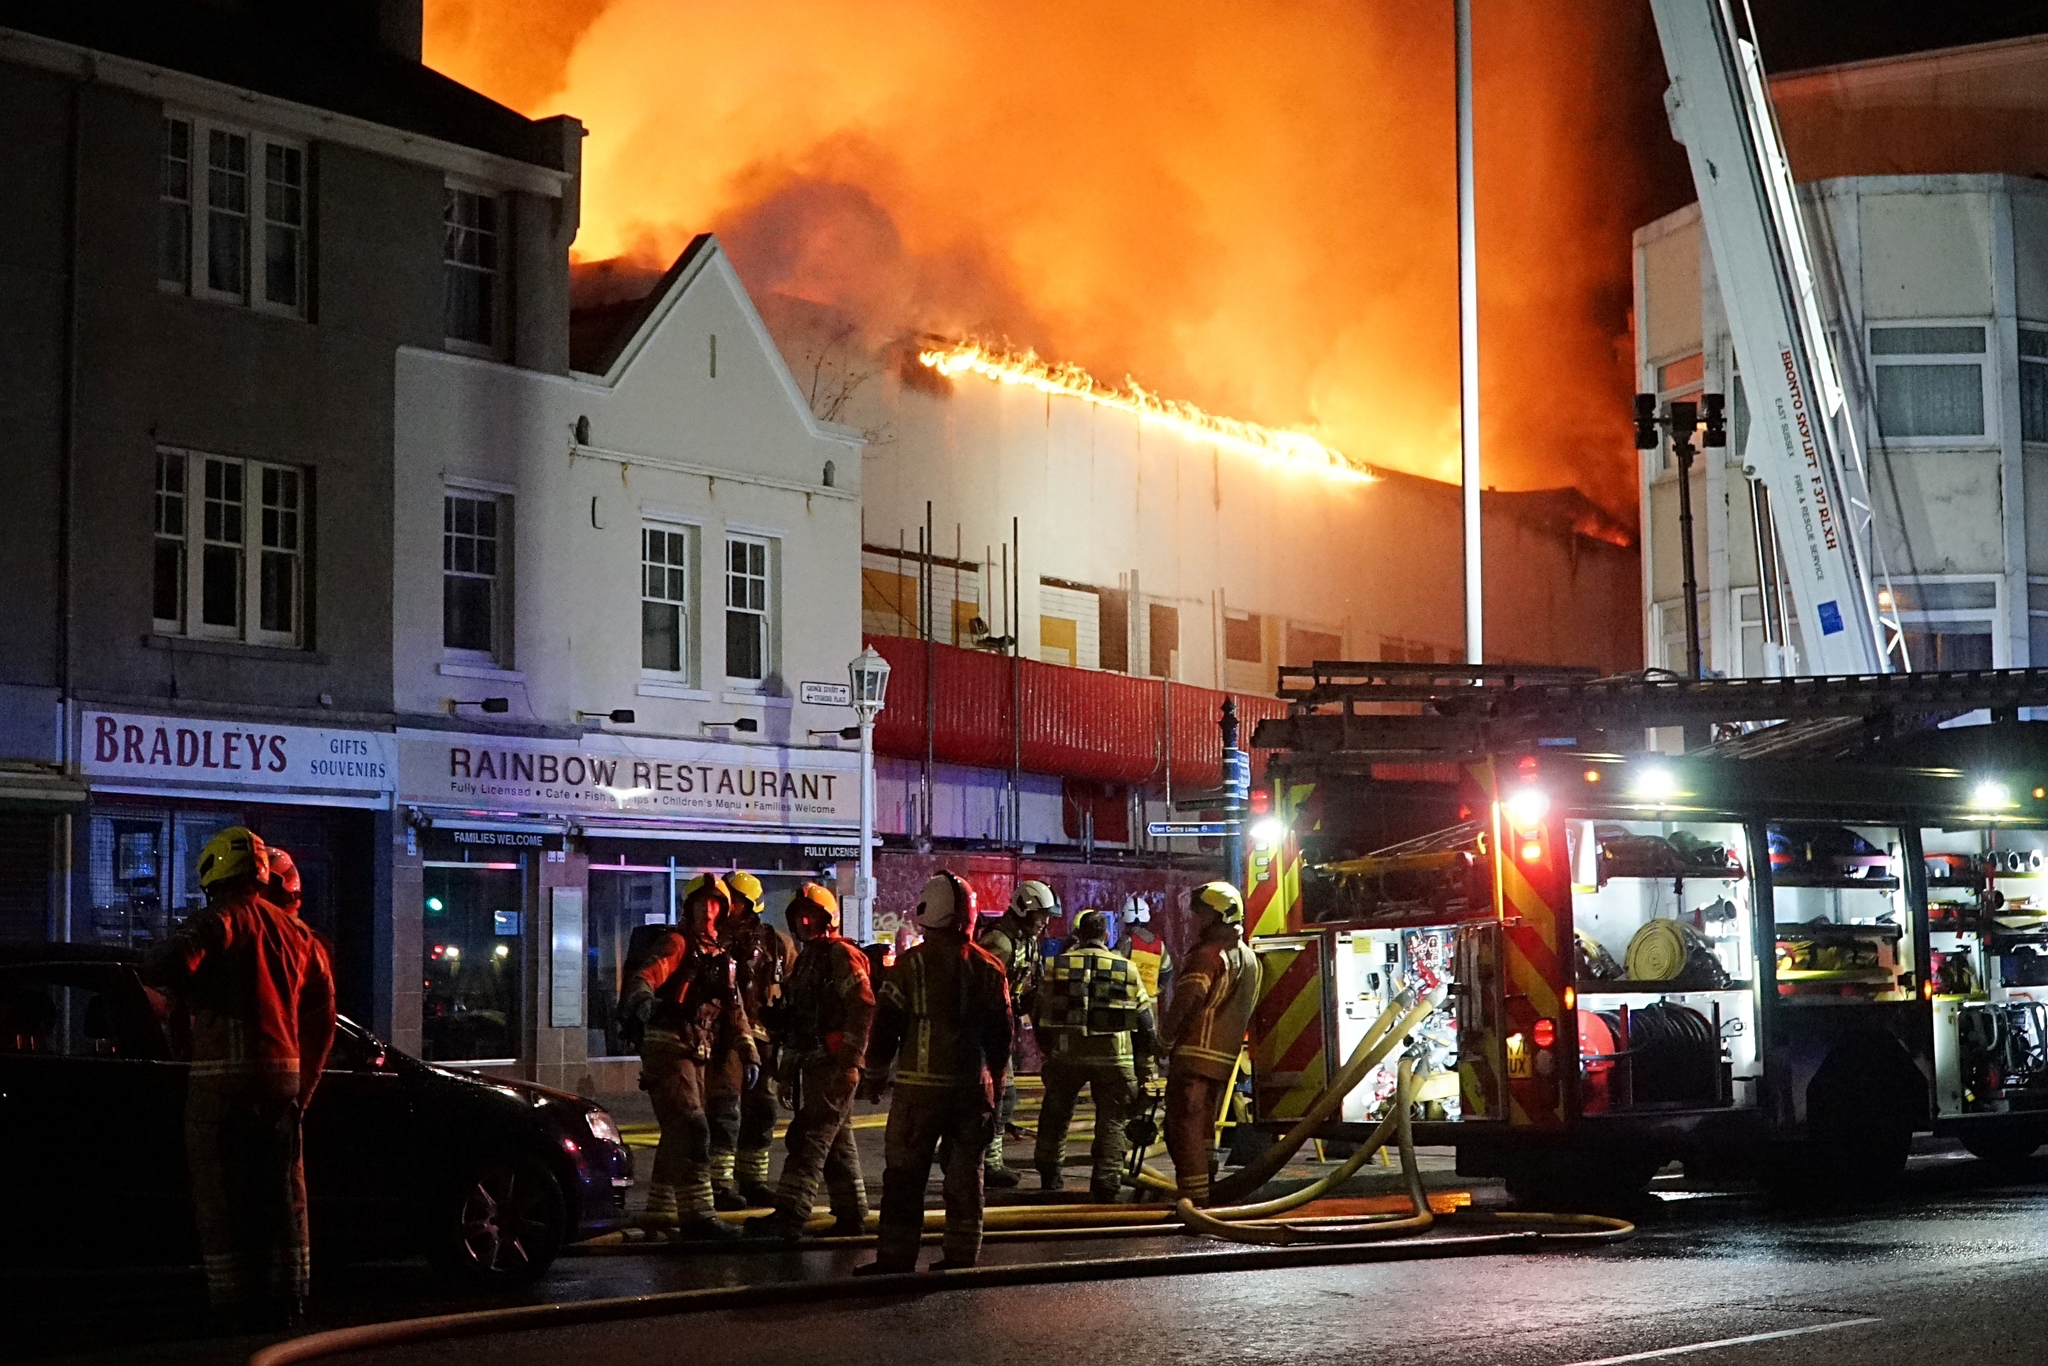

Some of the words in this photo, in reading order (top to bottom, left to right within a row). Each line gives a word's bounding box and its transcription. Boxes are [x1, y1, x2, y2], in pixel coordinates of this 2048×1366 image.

[1774, 397, 1787, 421] EAST
[1781, 423, 1795, 458] SUSSEX
[1781, 350, 1803, 410] BRONTO
[1796, 412, 1818, 469] SKYLIFT
[1819, 507, 1837, 551] RLXH
[1794, 474, 1804, 495] FIRE
[1801, 506, 1815, 541] RESCUE
[1810, 543, 1825, 582] SERVICE
[94, 716, 287, 773] BRADLEYS
[329, 738, 368, 756] GIFTS
[310, 759, 386, 779] SOUVENIRS
[451, 747, 618, 787] RAINBOW
[632, 761, 837, 800] RESTAURANT
[451, 782, 477, 795] Fully
[481, 784, 531, 797] Licensed
[546, 788, 570, 799] Cafe
[585, 790, 606, 801] Fish
[662, 795, 713, 808] Children's
[715, 798, 742, 810] Menu
[753, 800, 792, 812] Families
[794, 803, 836, 814] Welcome
[454, 831, 497, 845] FAMILIES
[497, 834, 543, 846] WELCOME
[804, 846, 827, 857] FULLY
[828, 847, 861, 858] LICENSE
